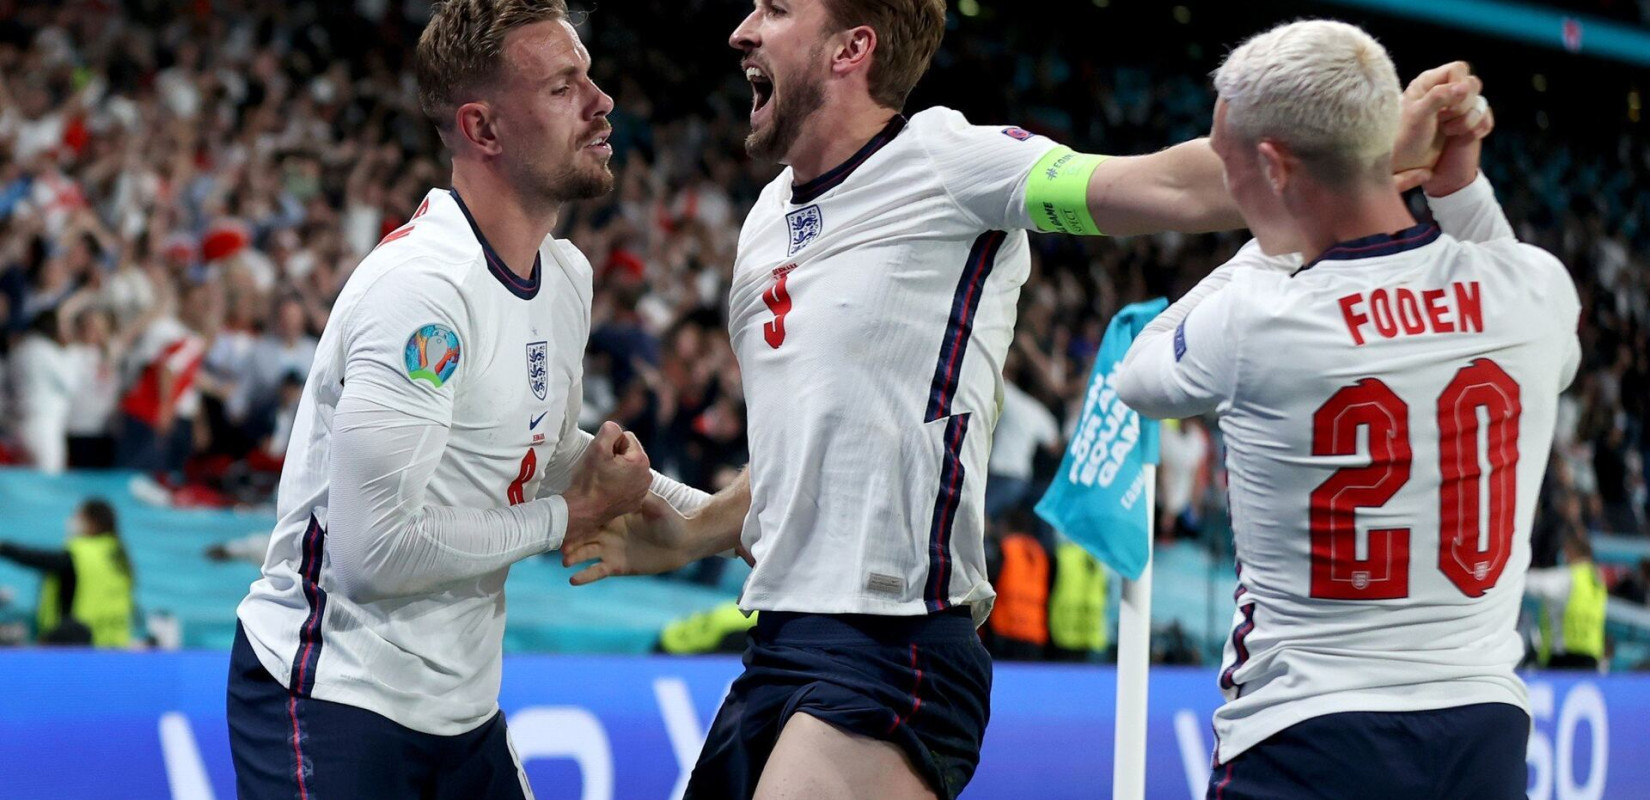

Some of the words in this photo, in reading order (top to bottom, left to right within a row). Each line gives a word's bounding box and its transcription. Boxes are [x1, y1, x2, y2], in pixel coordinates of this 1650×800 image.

[762, 273, 792, 349] 9
[1337, 281, 1484, 345] FODEN
[1080, 399, 1130, 488] EQUA
[1098, 410, 1140, 488] GAM
[1309, 357, 1522, 600] 20
